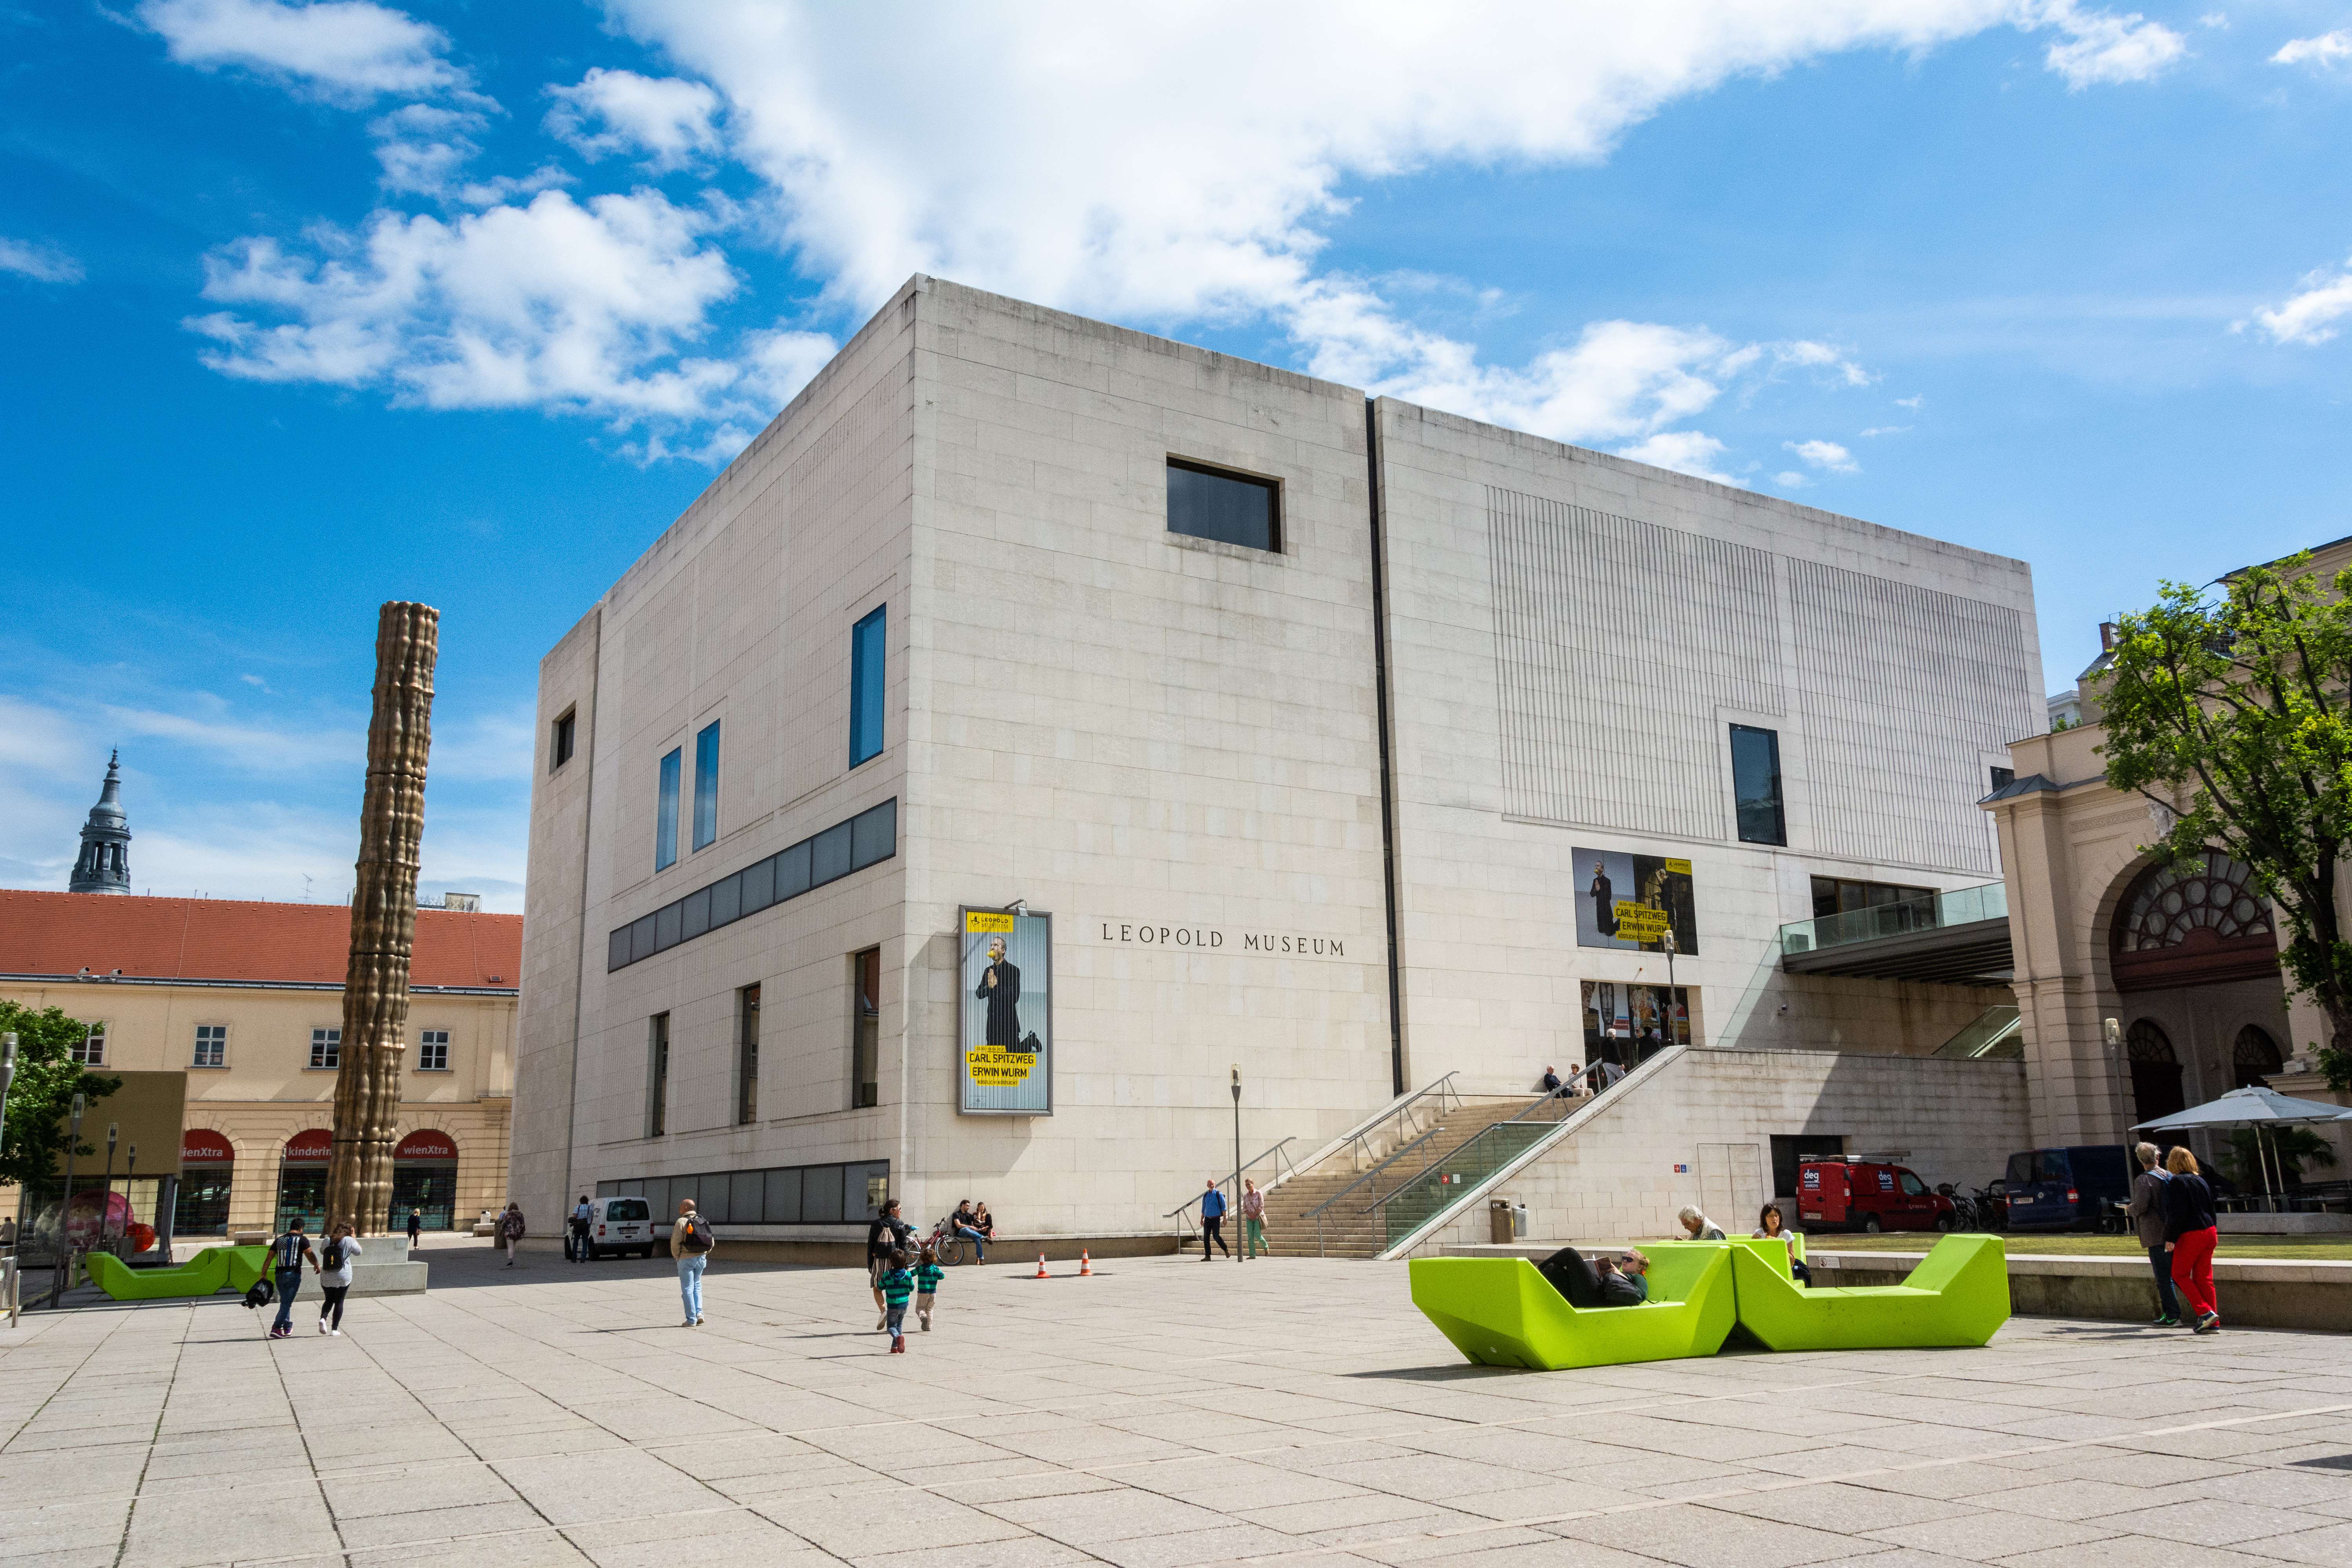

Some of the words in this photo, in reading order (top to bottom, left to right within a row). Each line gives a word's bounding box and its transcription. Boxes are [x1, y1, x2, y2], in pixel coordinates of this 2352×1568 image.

[1616, 908, 1633, 918] CARL
[1634, 909, 1666, 921] SPITZWEG
[1622, 921, 1644, 931] ERWIN
[1646, 924, 1667, 933] WURM
[1103, 923, 1223, 947] LEOPOLD
[1244, 933, 1344, 956] MUSEUM
[969, 1053, 991, 1063] CARL
[993, 1054, 1034, 1064] SPITZWEG
[973, 1067, 999, 1076] ERWIN
[1001, 1067, 1027, 1077] WURM
[182, 1147, 223, 1157] ienXtra
[288, 1147, 332, 1156] kinderin
[403, 1145, 448, 1155] wienXtra
[1804, 1169, 1819, 1182] deg
[1878, 1171, 1892, 1183] deg
